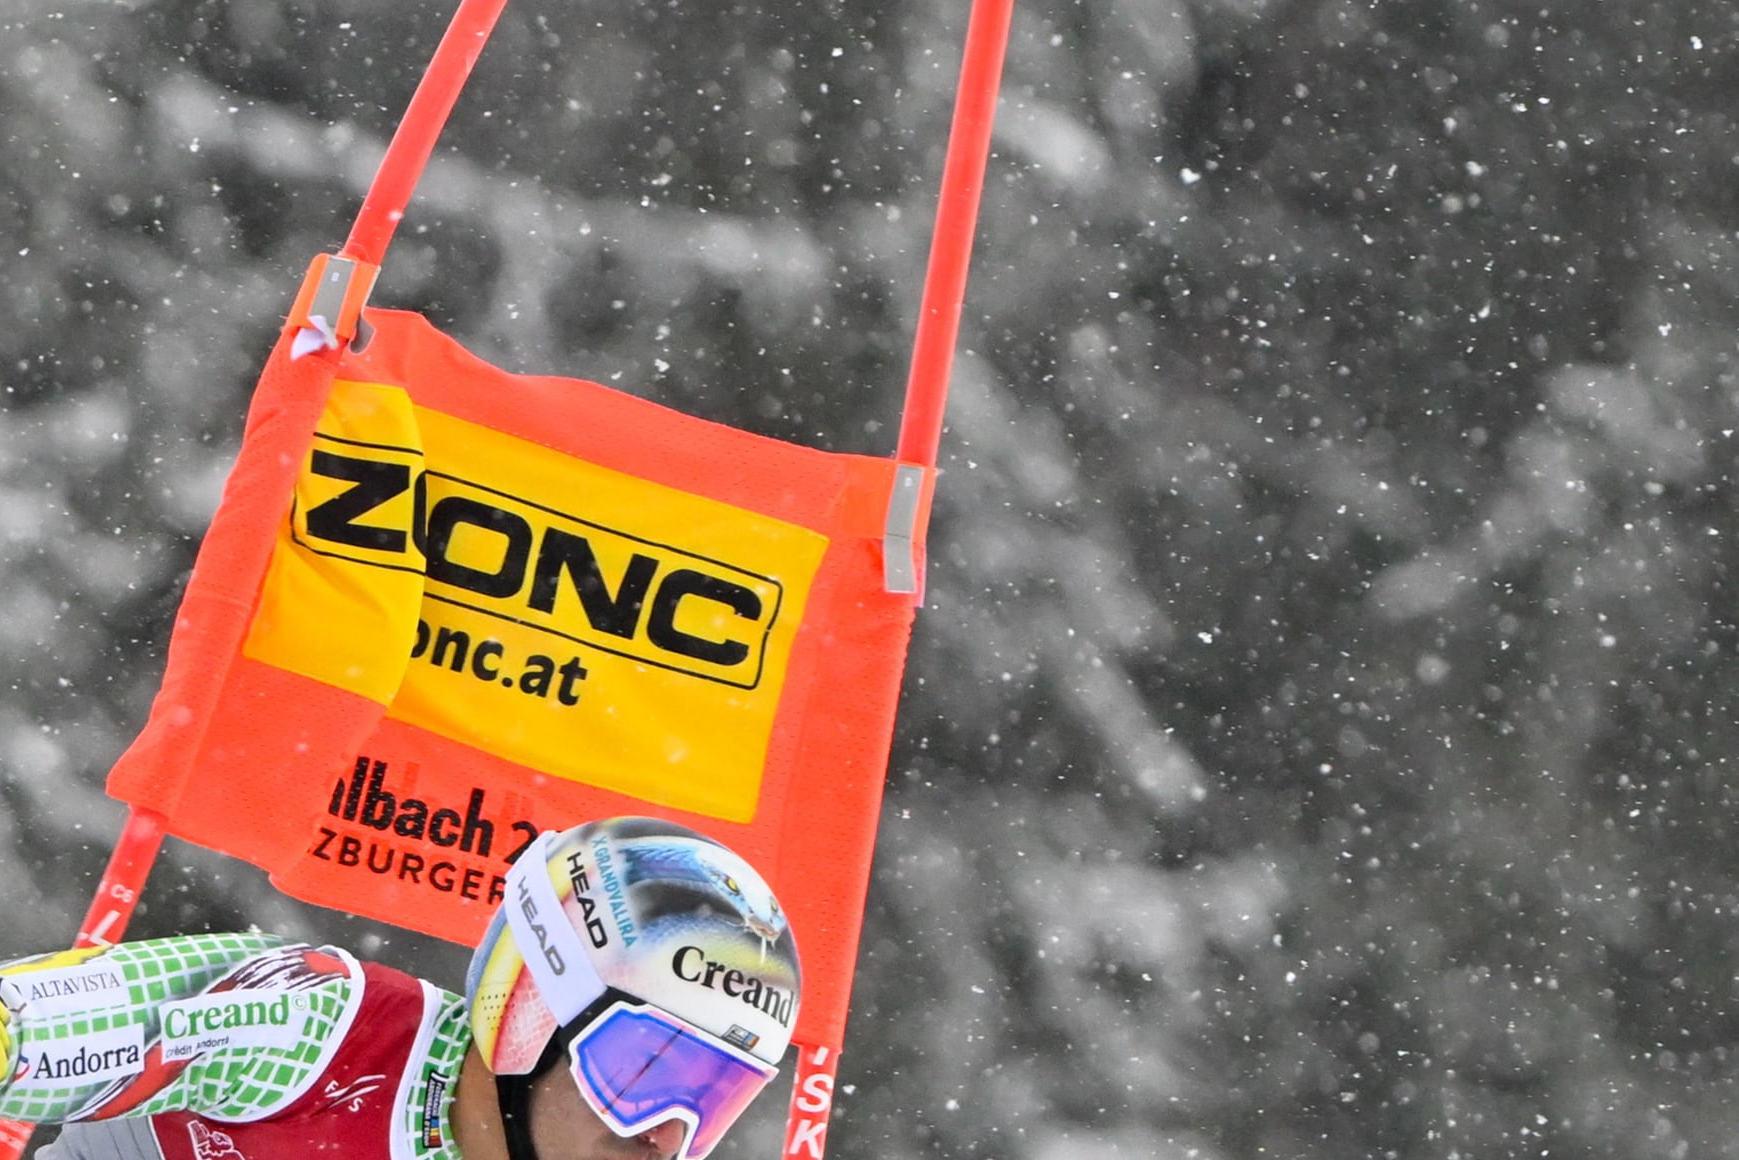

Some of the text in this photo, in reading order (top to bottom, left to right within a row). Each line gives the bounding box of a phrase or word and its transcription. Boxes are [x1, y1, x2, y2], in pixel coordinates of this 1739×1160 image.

[305, 449, 762, 667] ZONC
[410, 617, 588, 707] onc.at
[311, 827, 508, 905] ZBURGER
[567, 851, 608, 950] HEAD
[593, 847, 639, 949] GRANDVALIRA
[517, 875, 566, 976] HEAD
[31, 972, 121, 1000] ALTAVISTA
[164, 993, 290, 1040] Creand
[671, 945, 796, 1028] Creand
[33, 1043, 140, 1080] Andorra
